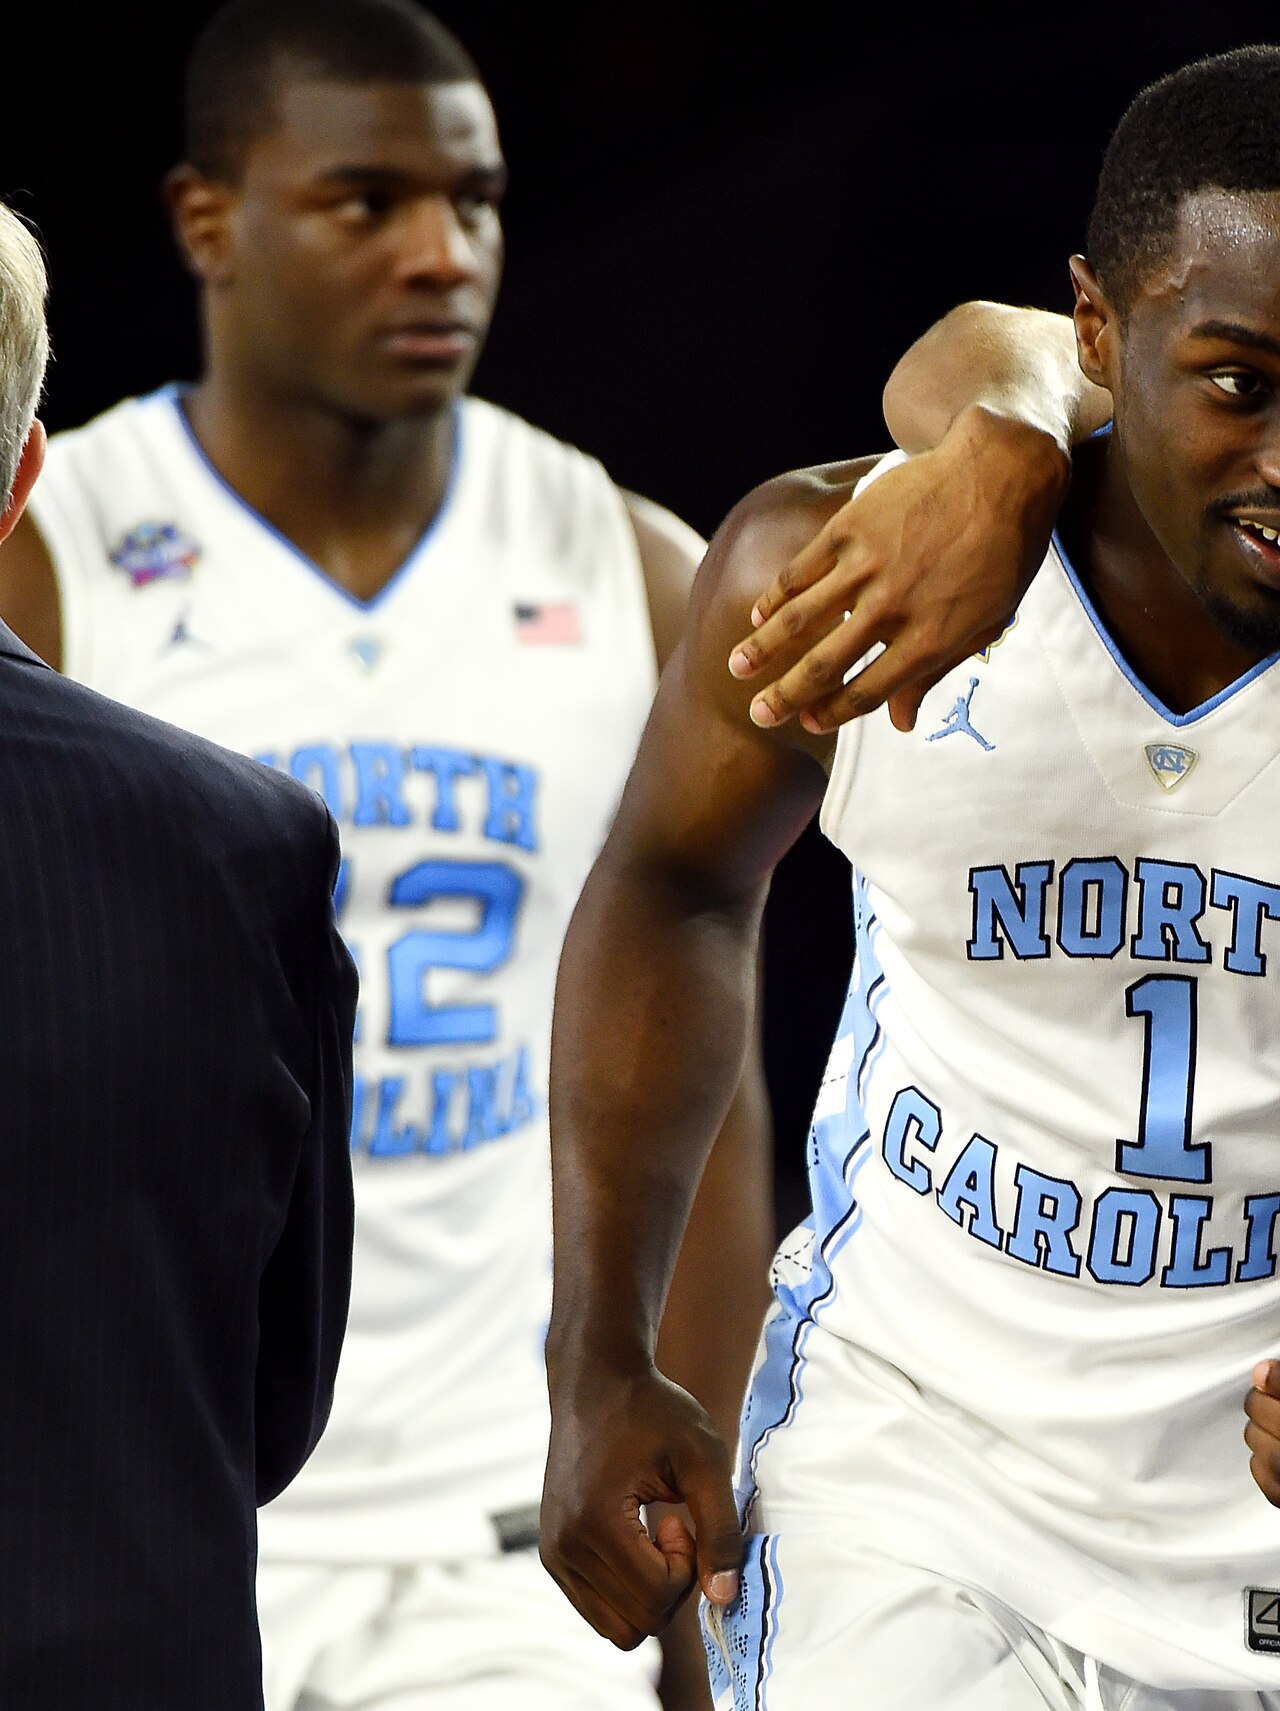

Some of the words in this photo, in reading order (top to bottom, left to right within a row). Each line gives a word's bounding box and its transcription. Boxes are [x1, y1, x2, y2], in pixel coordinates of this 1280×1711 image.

[254, 740, 541, 854] ORTH
[332, 856, 528, 1050] 2
[1115, 973, 1212, 1183] 1
